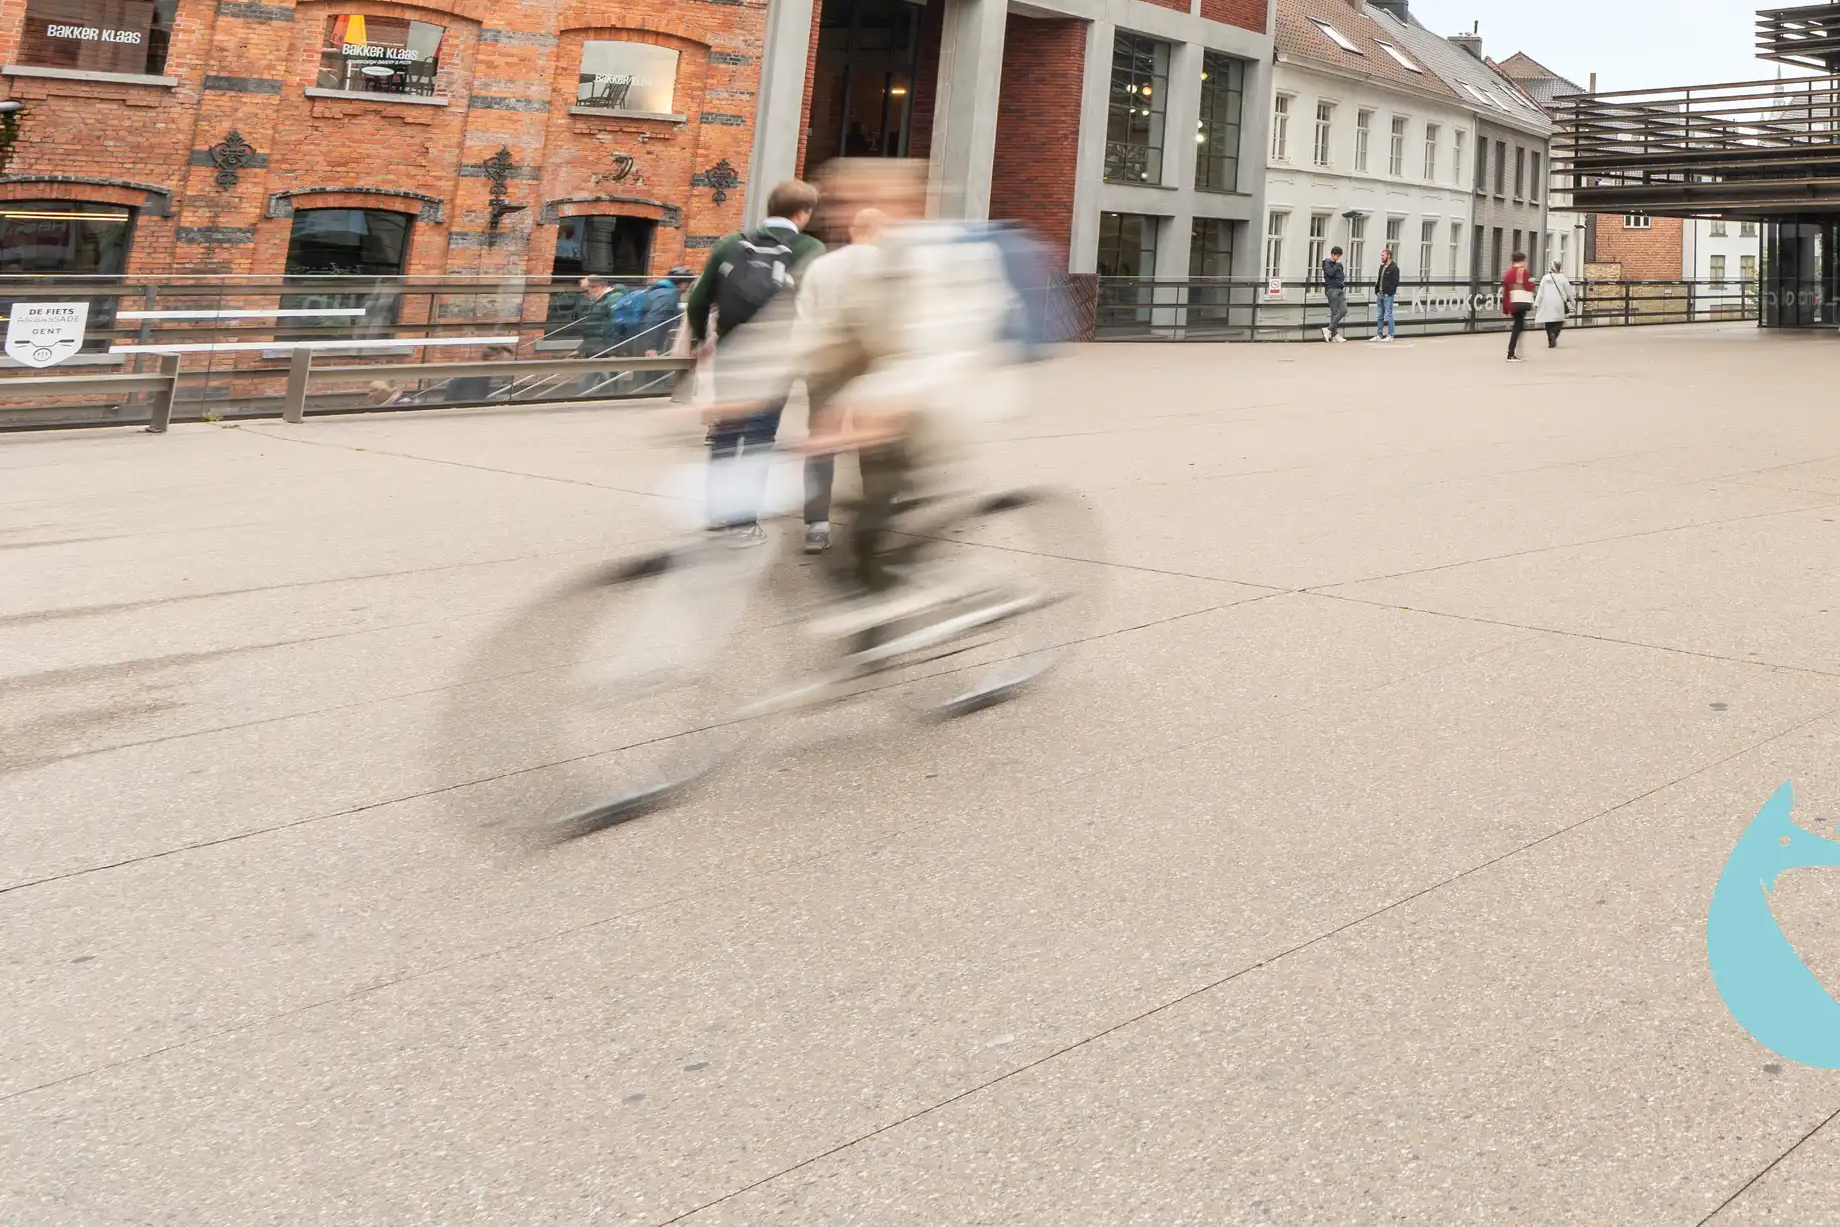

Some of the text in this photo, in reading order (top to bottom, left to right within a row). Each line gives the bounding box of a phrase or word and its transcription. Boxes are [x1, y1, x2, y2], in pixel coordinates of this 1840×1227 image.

[1411, 286, 1504, 314] Krookcaf
[29, 308, 43, 316] DE
[17, 315, 80, 324] AMBASSADE
